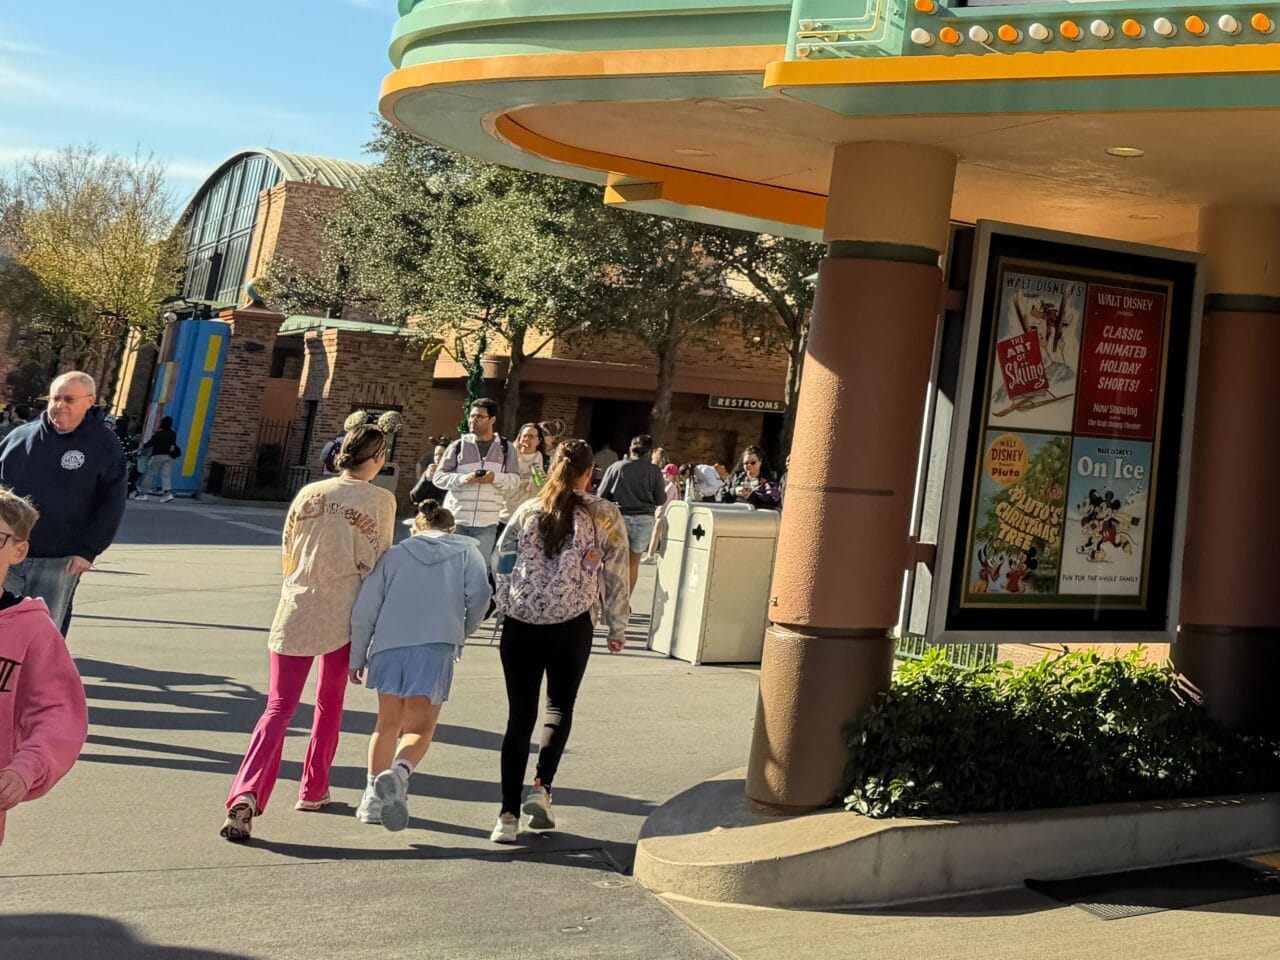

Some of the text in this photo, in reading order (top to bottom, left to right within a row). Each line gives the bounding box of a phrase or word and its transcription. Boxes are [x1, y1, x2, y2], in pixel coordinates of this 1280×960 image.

[1007, 276, 1031, 289] WALT
[1098, 293, 1154, 312] WALT DISNEY
[1103, 325, 1143, 340] CLASSIC
[1011, 336, 1024, 346] THE
[1007, 341, 1032, 358] ART
[1016, 353, 1026, 361] OF
[1095, 342, 1147, 359] ANIMATED
[1005, 361, 1045, 389] Skiing
[1099, 360, 1141, 375] HOLIDAY
[1097, 377, 1140, 392] SHORTS!
[717, 398, 779, 409] RESTROOMS
[991, 449, 1023, 461] DISNEY
[992, 468, 1019, 477] Pluto
[1078, 456, 1144, 479] On Ice
[1008, 488, 1063, 524] PLUTO'S
[996, 502, 1060, 546] CHRISTMAS
[999, 523, 1034, 551] TREE
